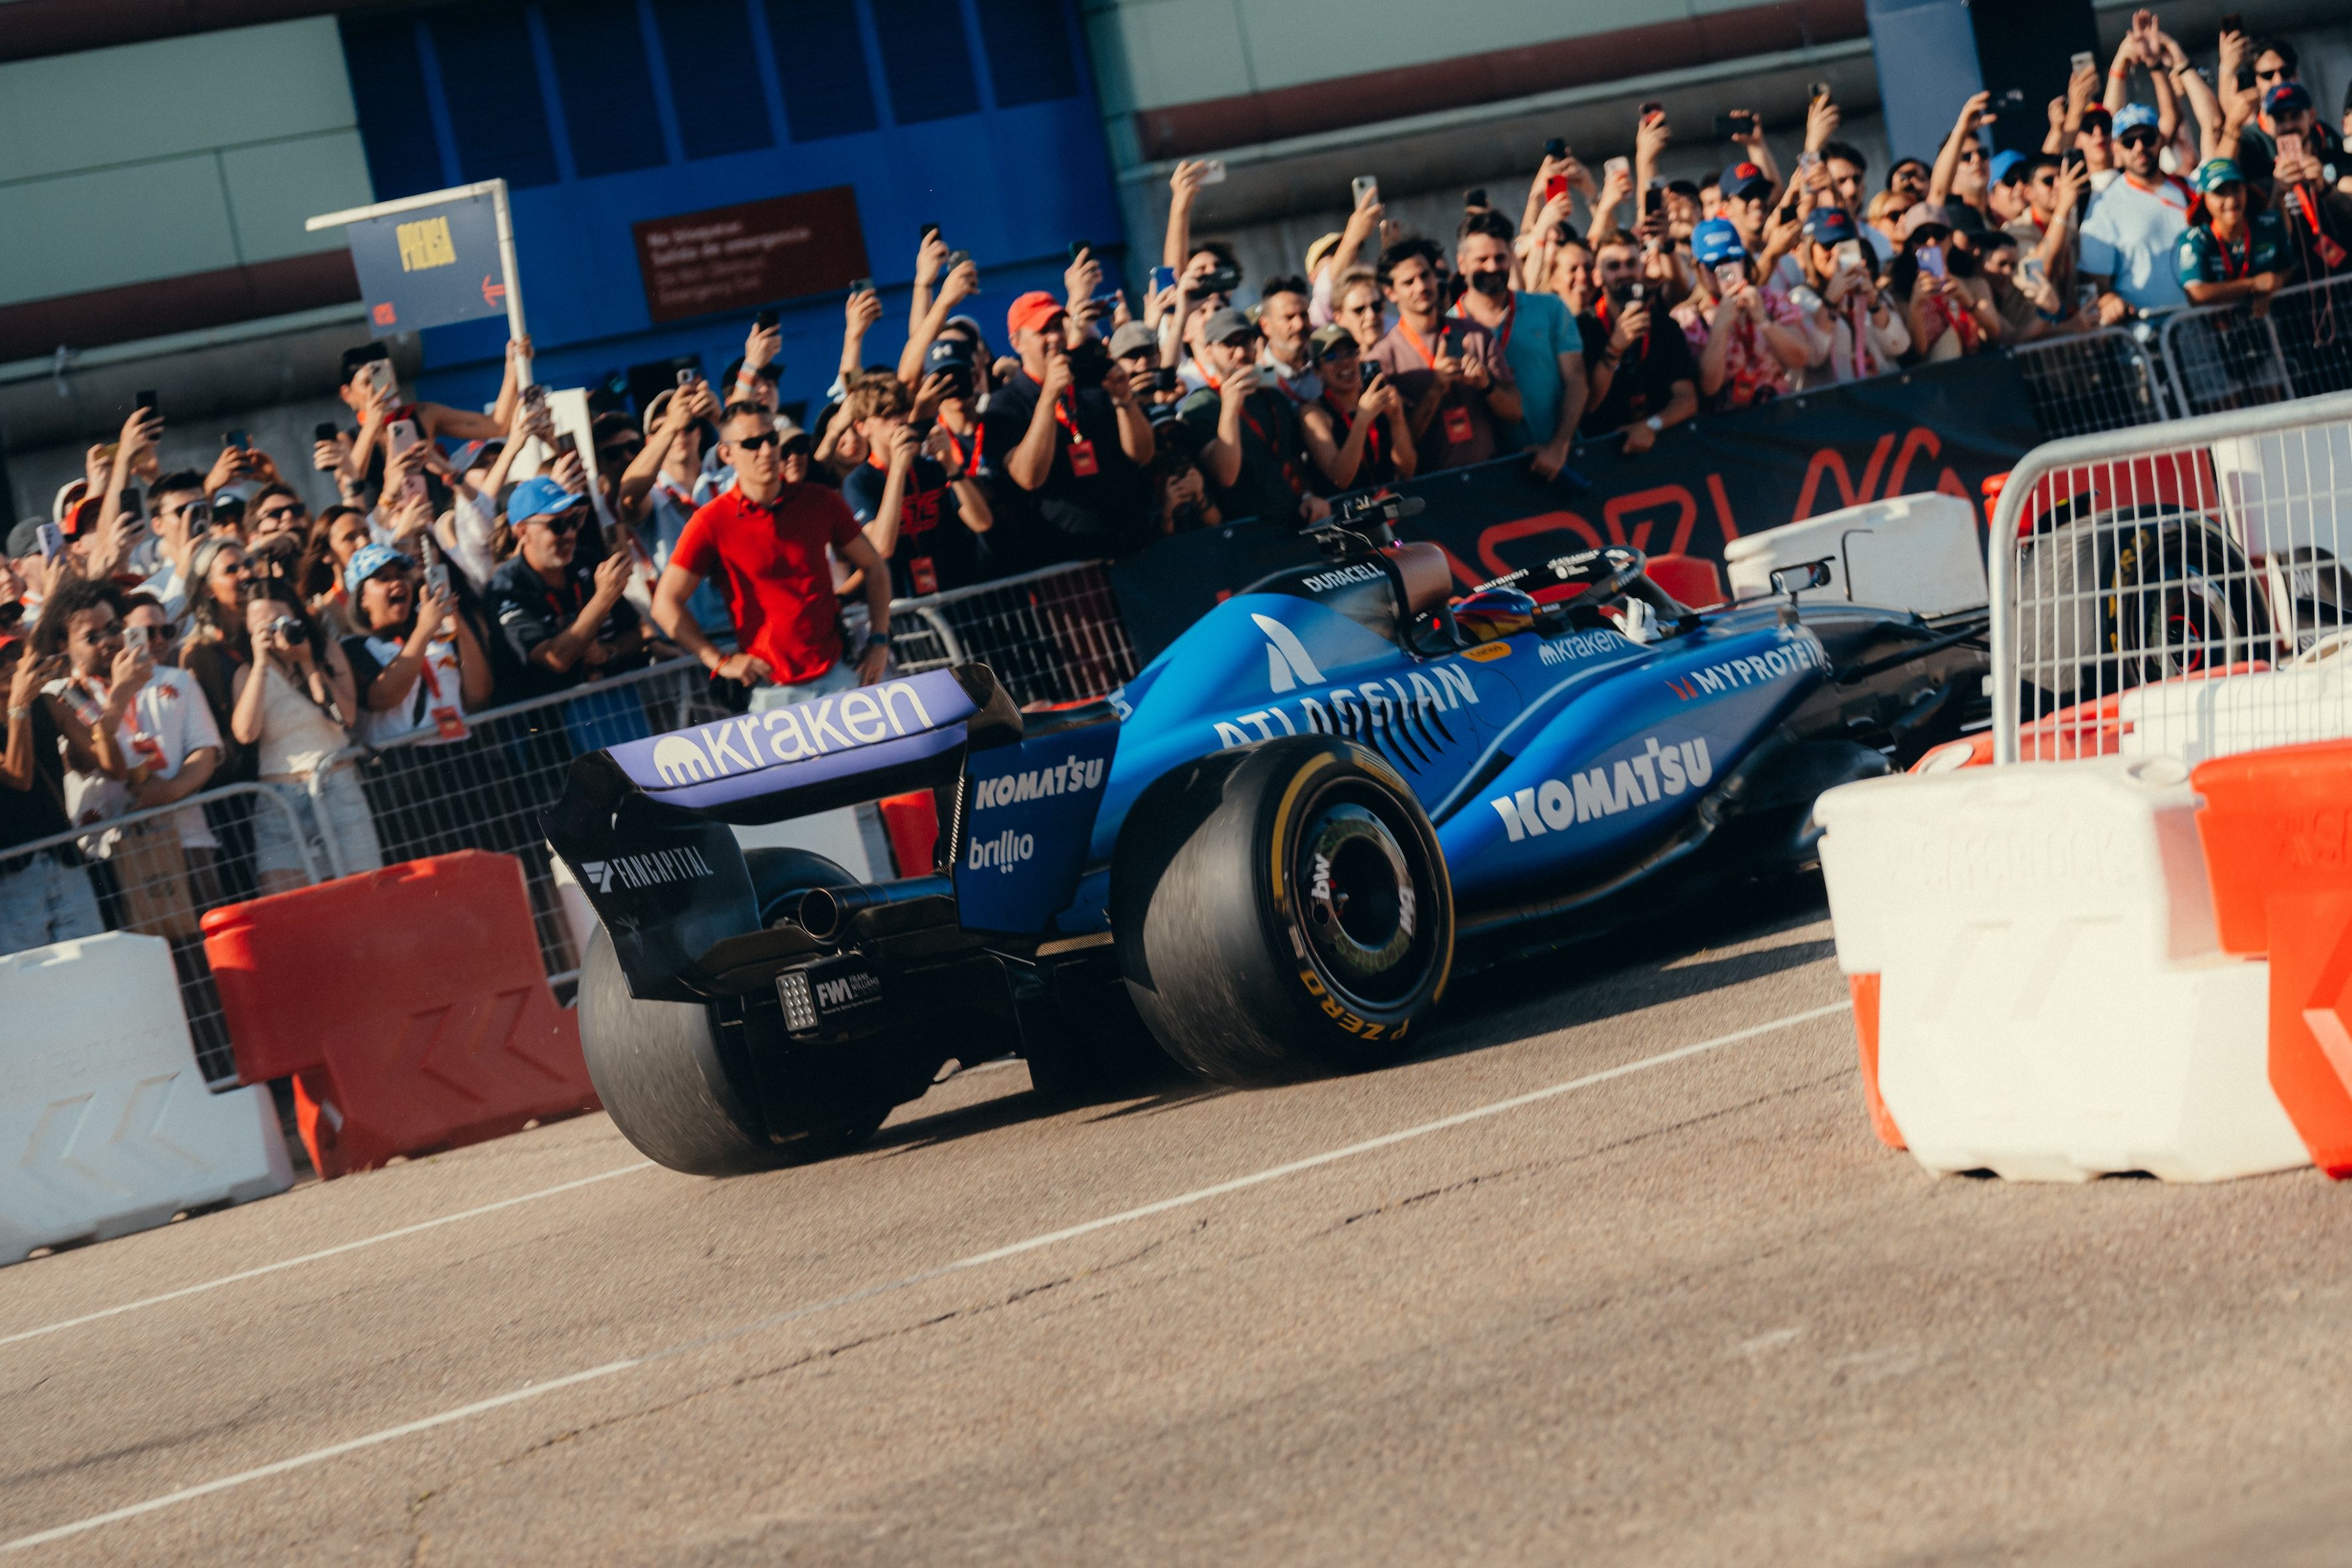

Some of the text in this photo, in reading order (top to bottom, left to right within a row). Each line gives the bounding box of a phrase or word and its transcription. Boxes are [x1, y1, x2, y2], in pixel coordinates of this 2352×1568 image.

[1302, 562, 1386, 593] DURACELL
[1554, 629, 1625, 660] kraken
[1690, 638, 1826, 694] MYPROTEIN
[700, 681, 935, 775] kraken
[975, 754, 1105, 811] KOMATSU
[1490, 736, 1713, 843] KOMATSU
[1298, 969, 1410, 1042] P ZERO
